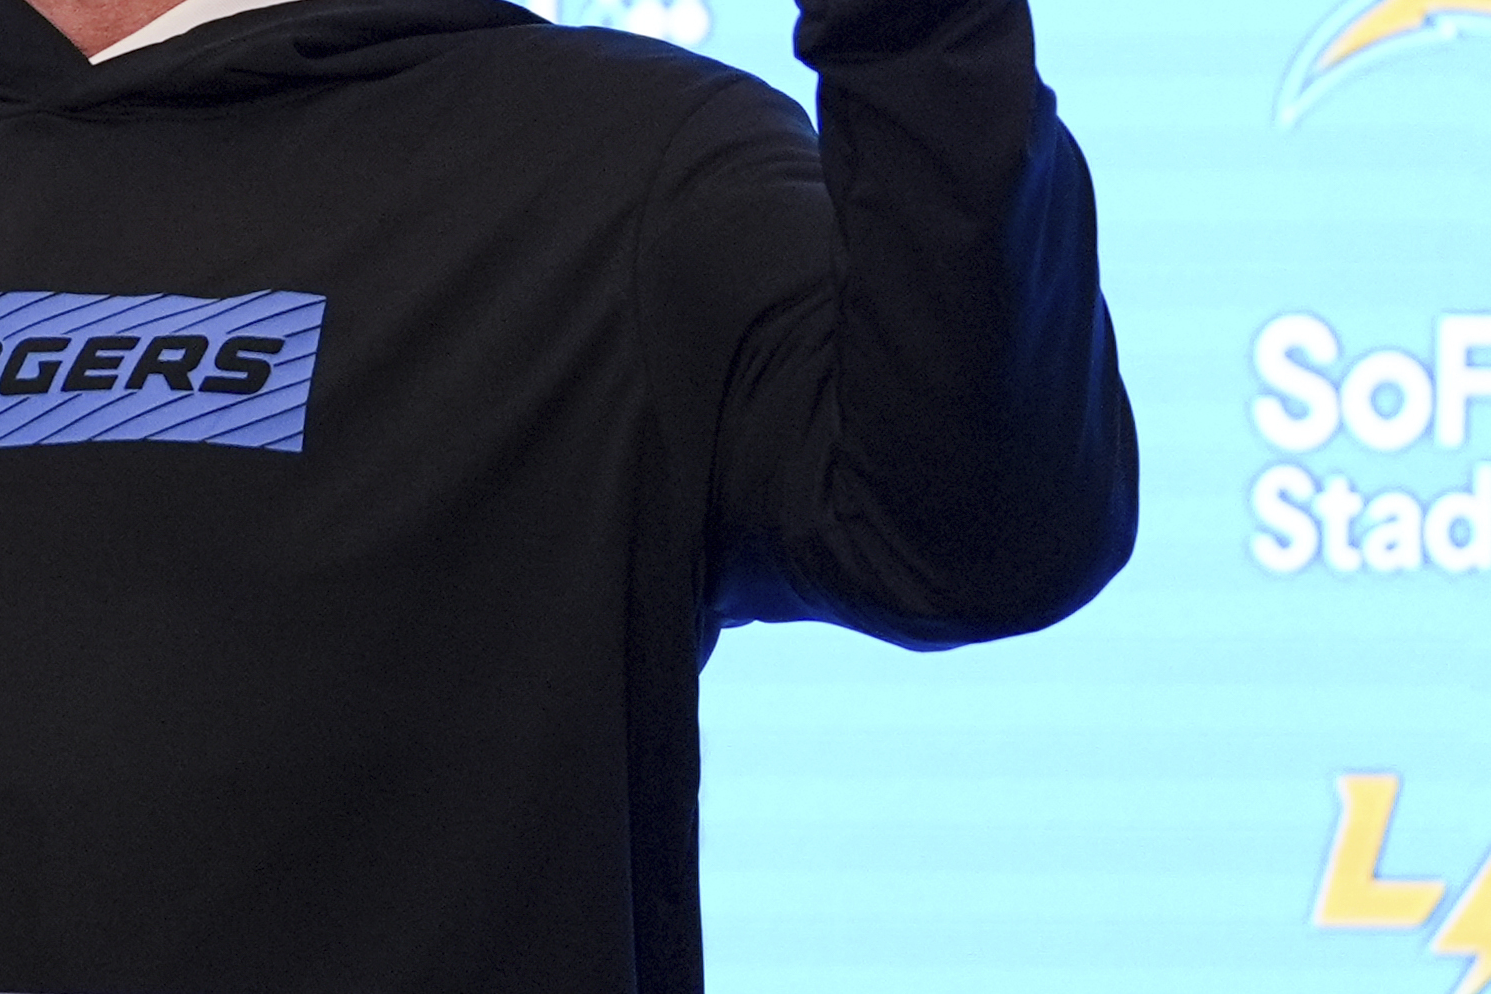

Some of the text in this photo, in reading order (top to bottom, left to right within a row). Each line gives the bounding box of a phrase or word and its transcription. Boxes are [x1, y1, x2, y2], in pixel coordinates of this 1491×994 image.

[1251, 314, 1491, 452] SoF
[1251, 463, 1491, 572] Stad
[1312, 772, 1491, 994] L
